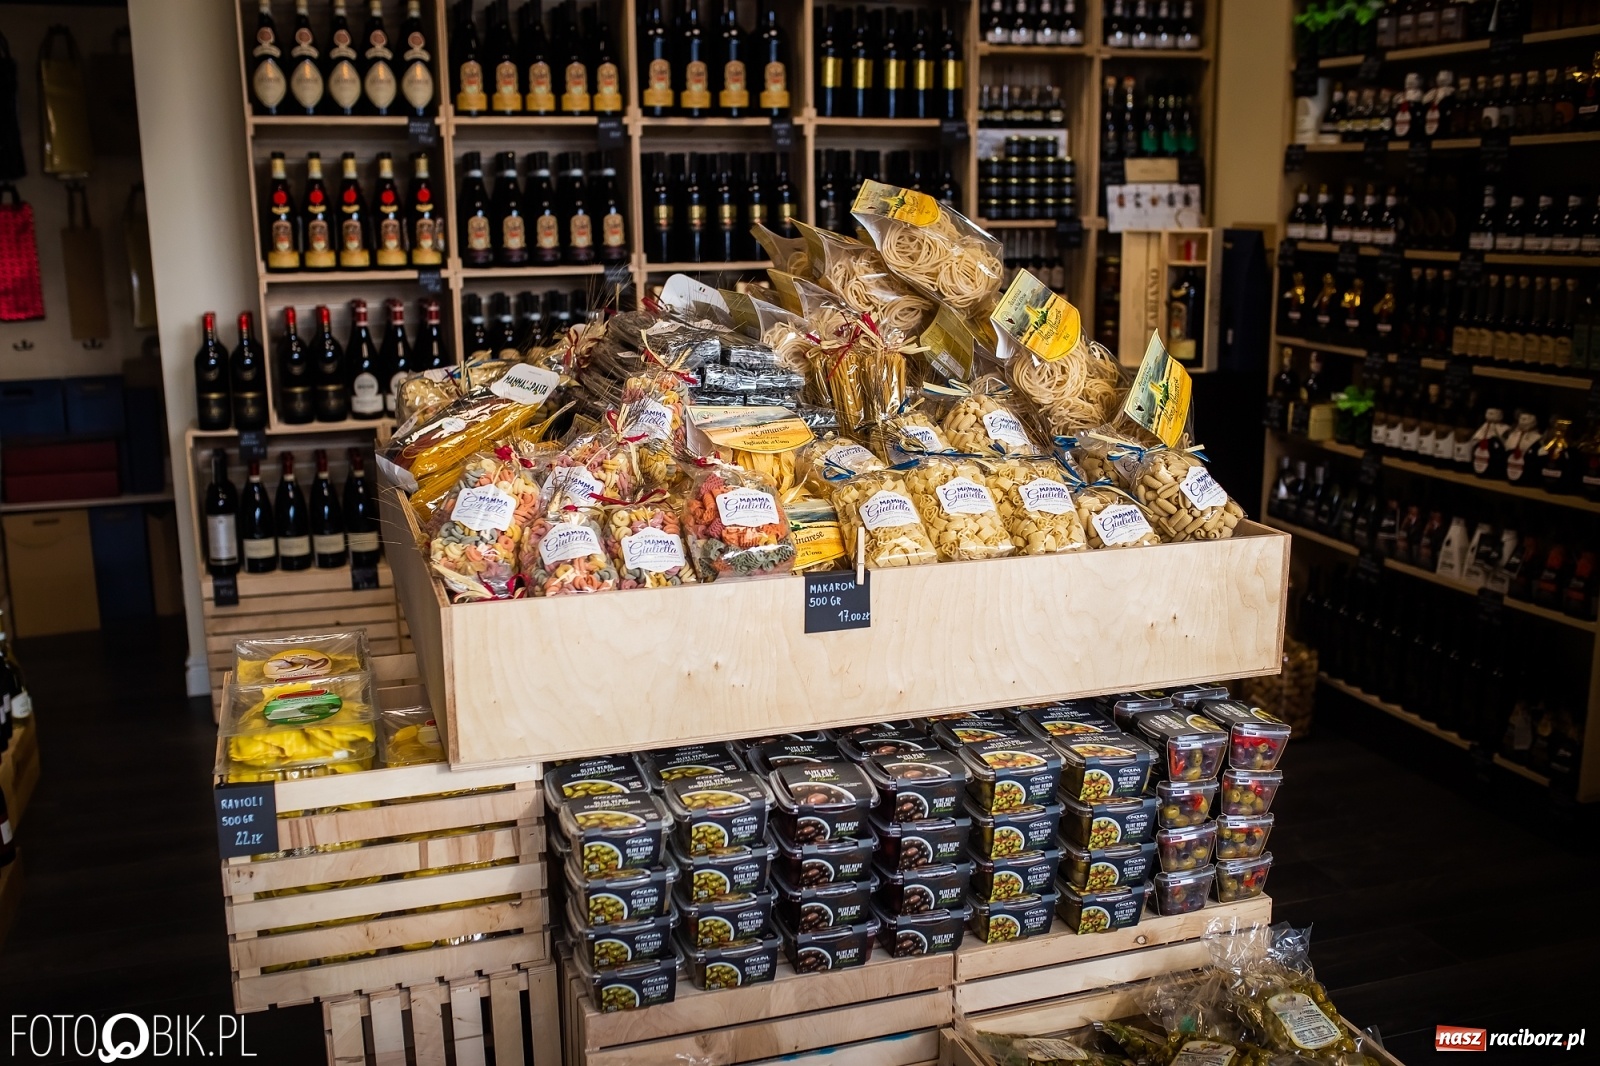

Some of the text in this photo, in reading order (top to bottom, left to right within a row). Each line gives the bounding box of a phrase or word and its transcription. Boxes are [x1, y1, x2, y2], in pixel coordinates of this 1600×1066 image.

[479, 495, 508, 507] MAMMA
[1112, 509, 1139, 520] MAMMA
[559, 530, 589, 539] MAMMA
[809, 580, 856, 594] MAKARON
[809, 596, 842, 608] 500 GR
[221, 796, 263, 810] RAVIOLI
[222, 814, 254, 826] 500 GR
